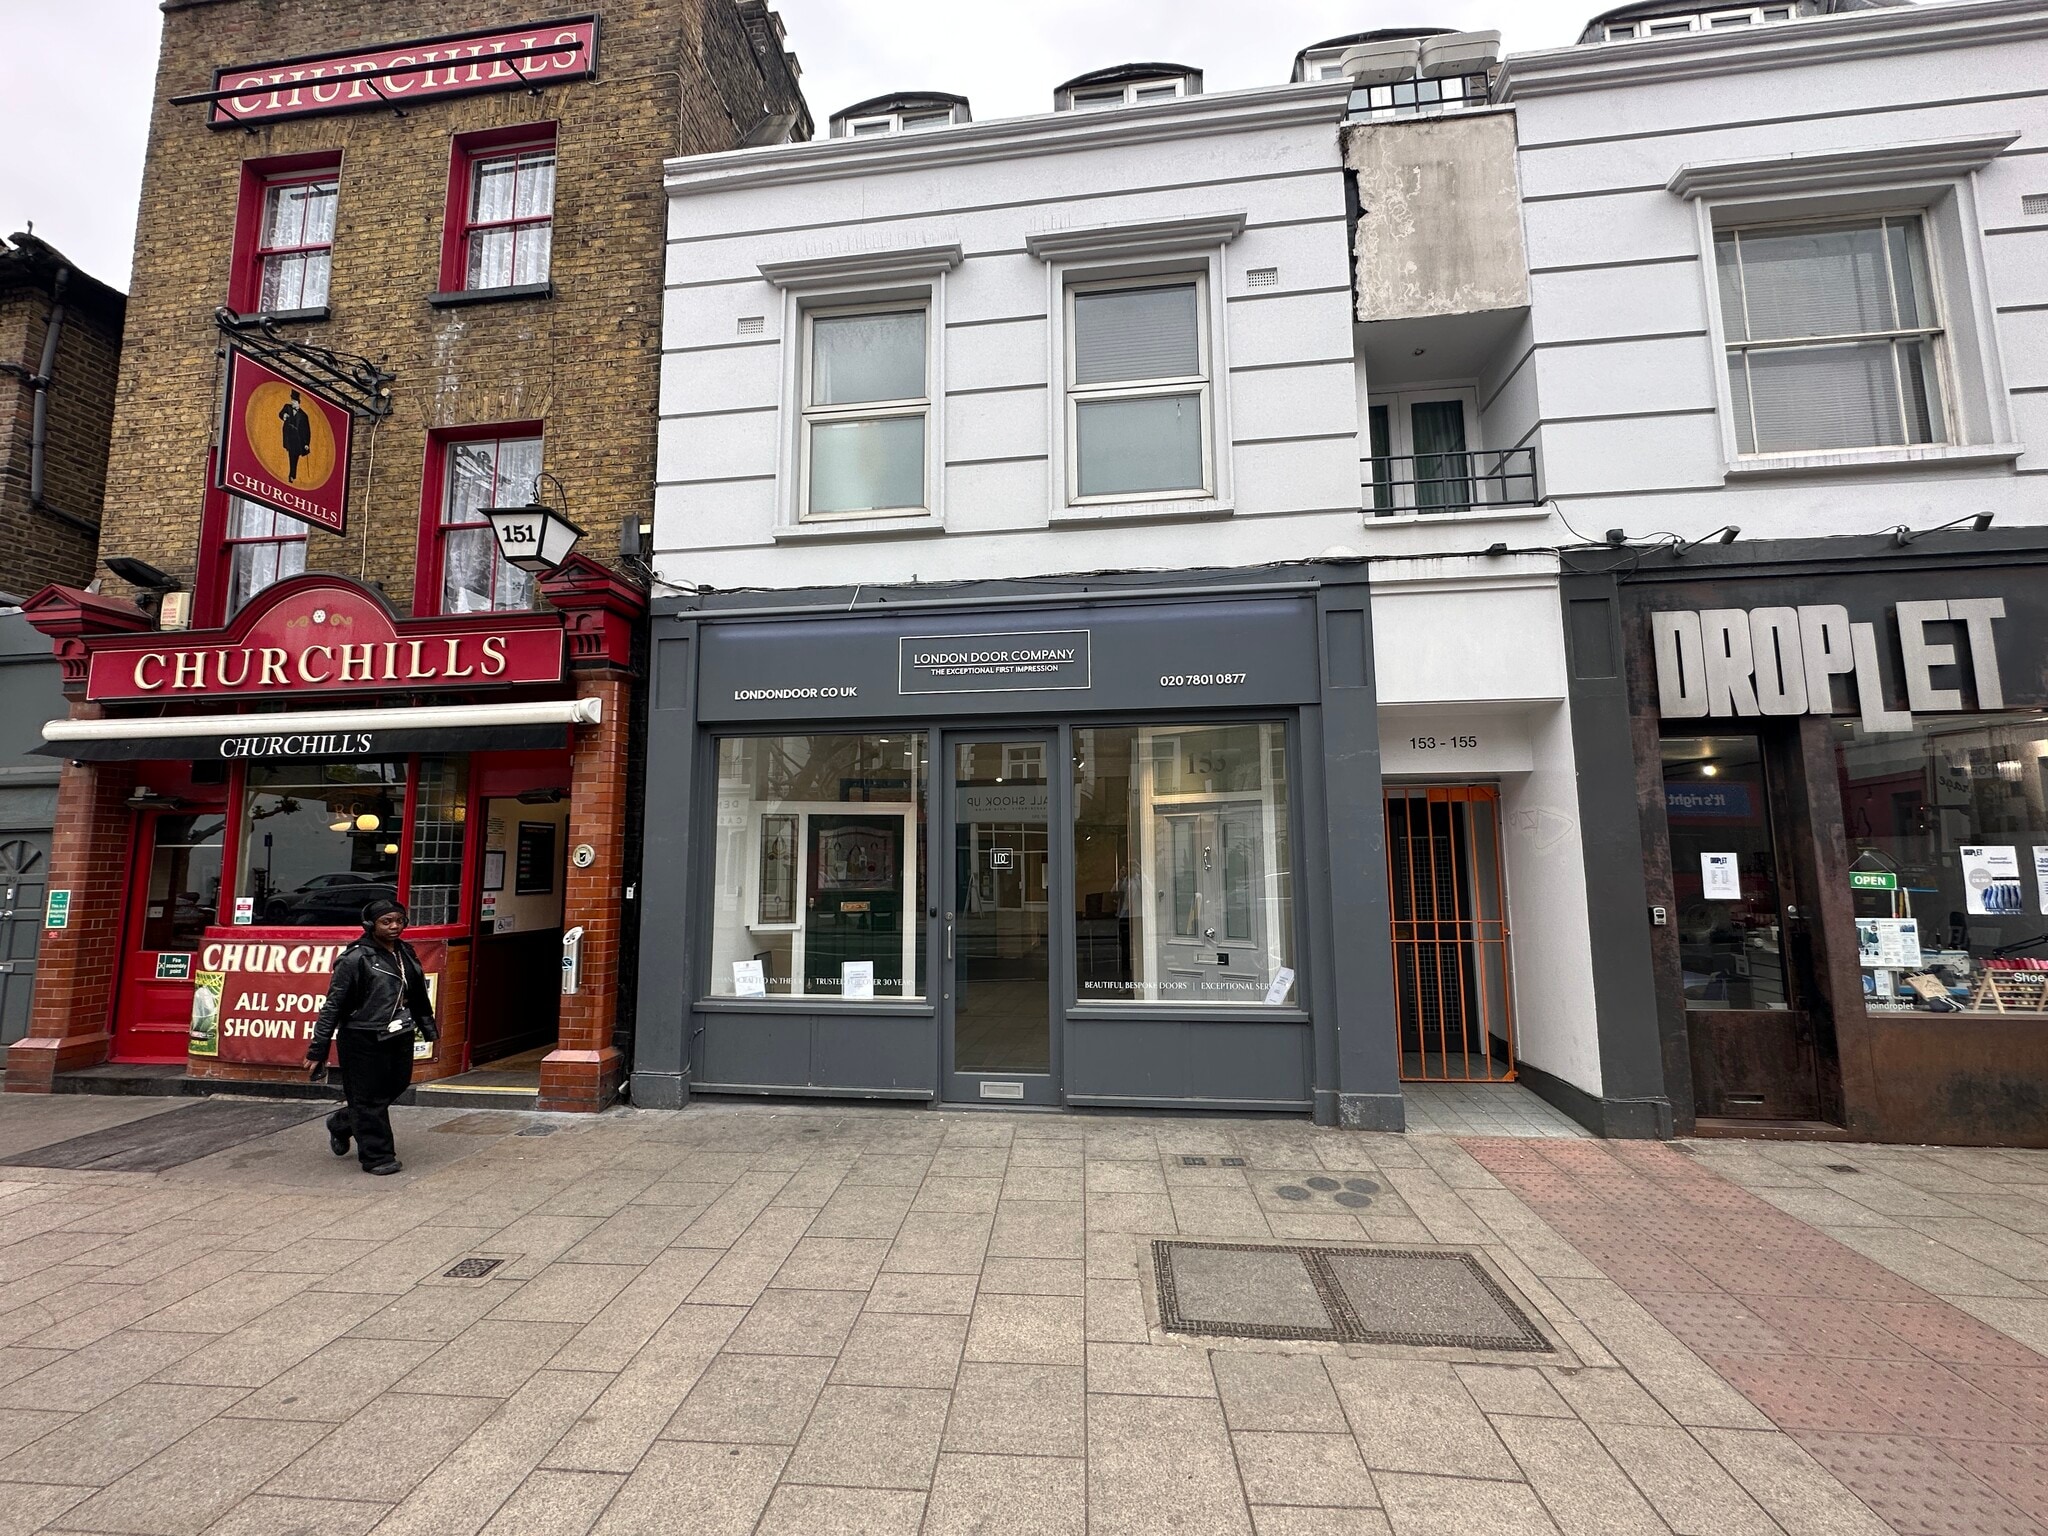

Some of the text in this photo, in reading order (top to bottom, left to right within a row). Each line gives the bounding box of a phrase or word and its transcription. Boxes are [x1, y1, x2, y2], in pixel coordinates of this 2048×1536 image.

[231, 31, 577, 113] CHURCHILLS
[232, 472, 338, 523] CHURCHILLS
[502, 524, 537, 543] 151
[133, 636, 508, 690] CHURCHILLS
[914, 649, 1075, 665] LONDON DOOR COMPANY
[931, 664, 1059, 676] THE EXCEPTIONAL FIRST IMPRESSION
[1651, 597, 2006, 733] DROPLET
[1160, 673, 1246, 687] 020 7801 0877
[219, 732, 373, 758] CHURCHILL'S
[1409, 736, 1436, 749] 153
[1450, 735, 1477, 748] 155
[994, 853, 1010, 865] LDC
[1855, 875, 1887, 886] OPEN
[883, 978, 892, 986] 30
[1084, 981, 1124, 989] BEAUTIFUL
[1159, 981, 1187, 989] DOORS
[2013, 972, 2046, 983] Shoe
[1201, 982, 1254, 990] EXCEPTIONAL
[234, 992, 270, 1012] ALL
[224, 1018, 296, 1040] SHOWN
